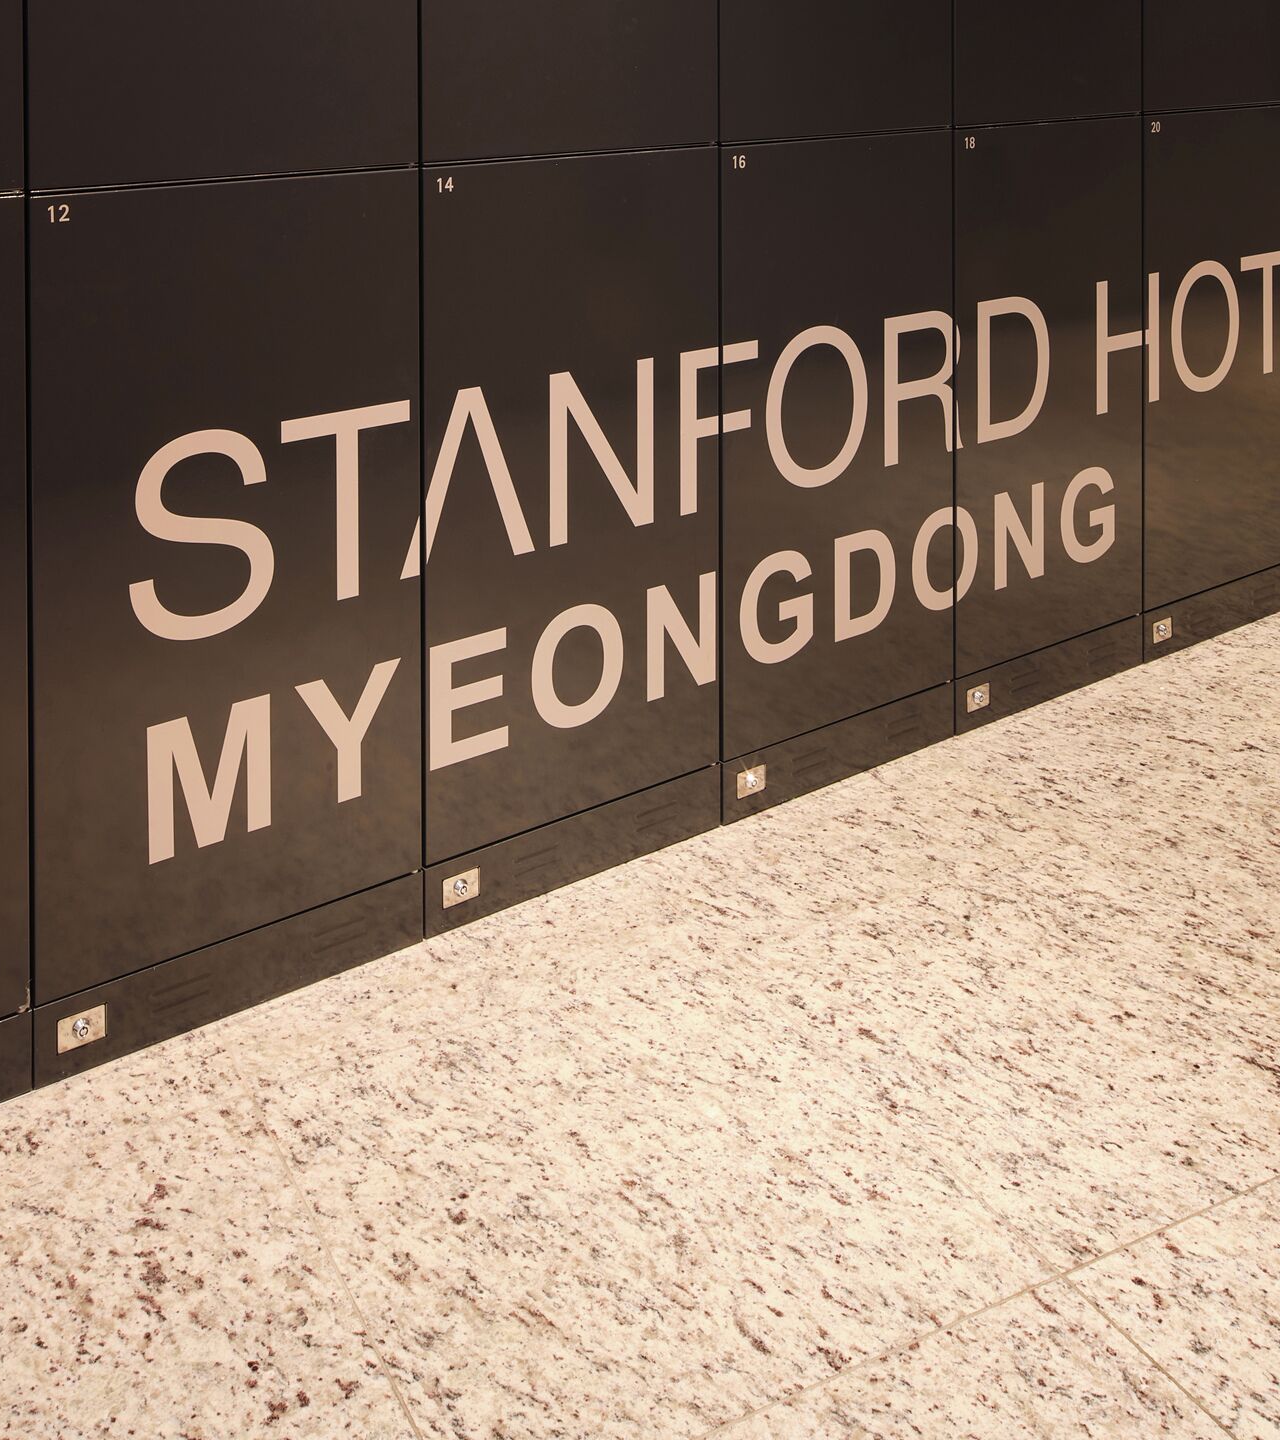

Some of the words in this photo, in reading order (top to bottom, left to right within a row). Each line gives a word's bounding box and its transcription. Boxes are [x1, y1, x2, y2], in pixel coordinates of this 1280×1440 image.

[1151, 121, 1161, 133] 20
[964, 136, 975, 149] 18
[732, 154, 746, 169] 16
[436, 176, 454, 193] 14
[47, 204, 70, 223] 12
[129, 296, 1050, 641] STANFORD
[146, 466, 1118, 866] MYEONGDONG
